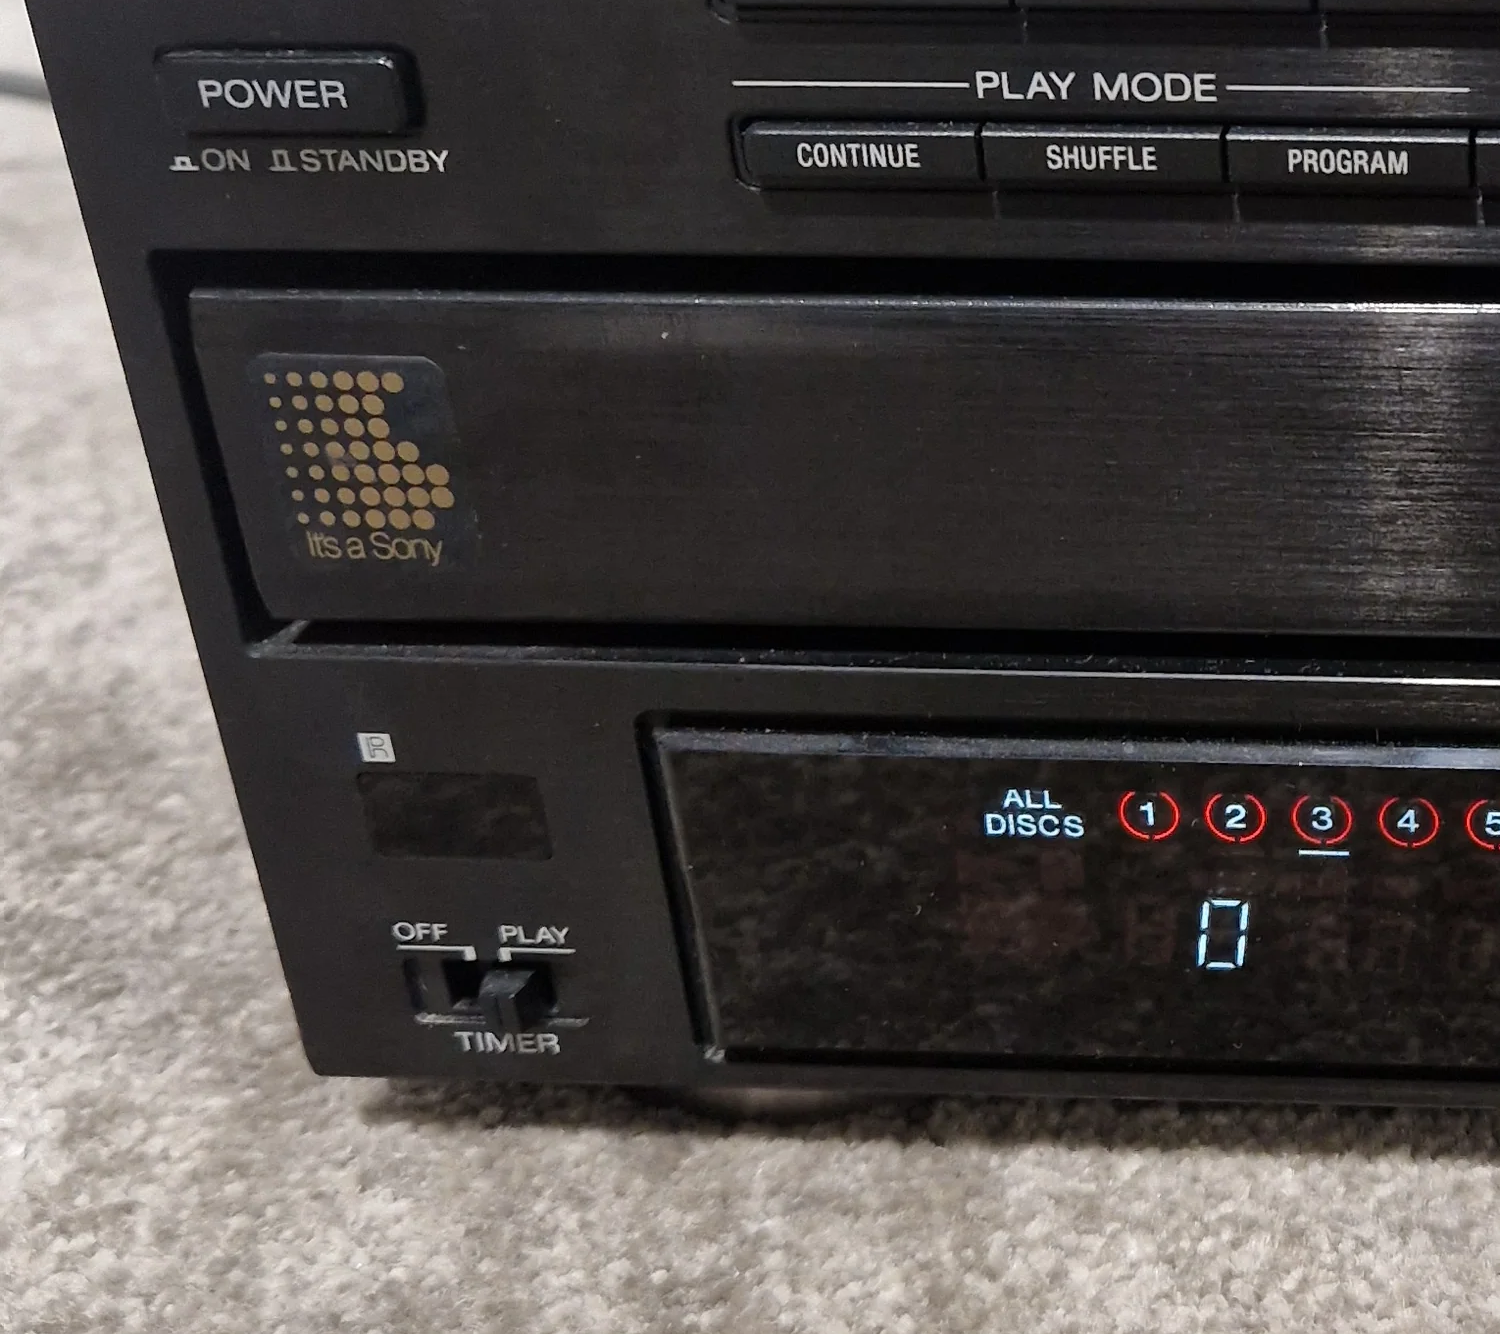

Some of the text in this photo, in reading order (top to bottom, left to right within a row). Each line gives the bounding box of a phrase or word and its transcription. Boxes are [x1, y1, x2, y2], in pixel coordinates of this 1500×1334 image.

[197, 79, 348, 109] POWER
[975, 70, 1218, 102] PLAY MODE
[201, 148, 449, 173] ON STANDBY
[796, 142, 921, 168] CONTINUE
[1046, 144, 1158, 171] SHUFFLE
[1287, 148, 1408, 175] PROGRAM
[345, 536, 367, 560] a
[370, 531, 443, 567] Sony
[1002, 788, 1063, 810] ALL
[983, 813, 1085, 838] DISCS
[1138, 801, 1156, 827] 1
[1225, 804, 1247, 829] 2
[1311, 806, 1333, 831] 3
[1397, 809, 1420, 833] 4
[391, 921, 449, 942] OFF
[497, 924, 569, 945] PLAY
[453, 1031, 561, 1055] TIMER
